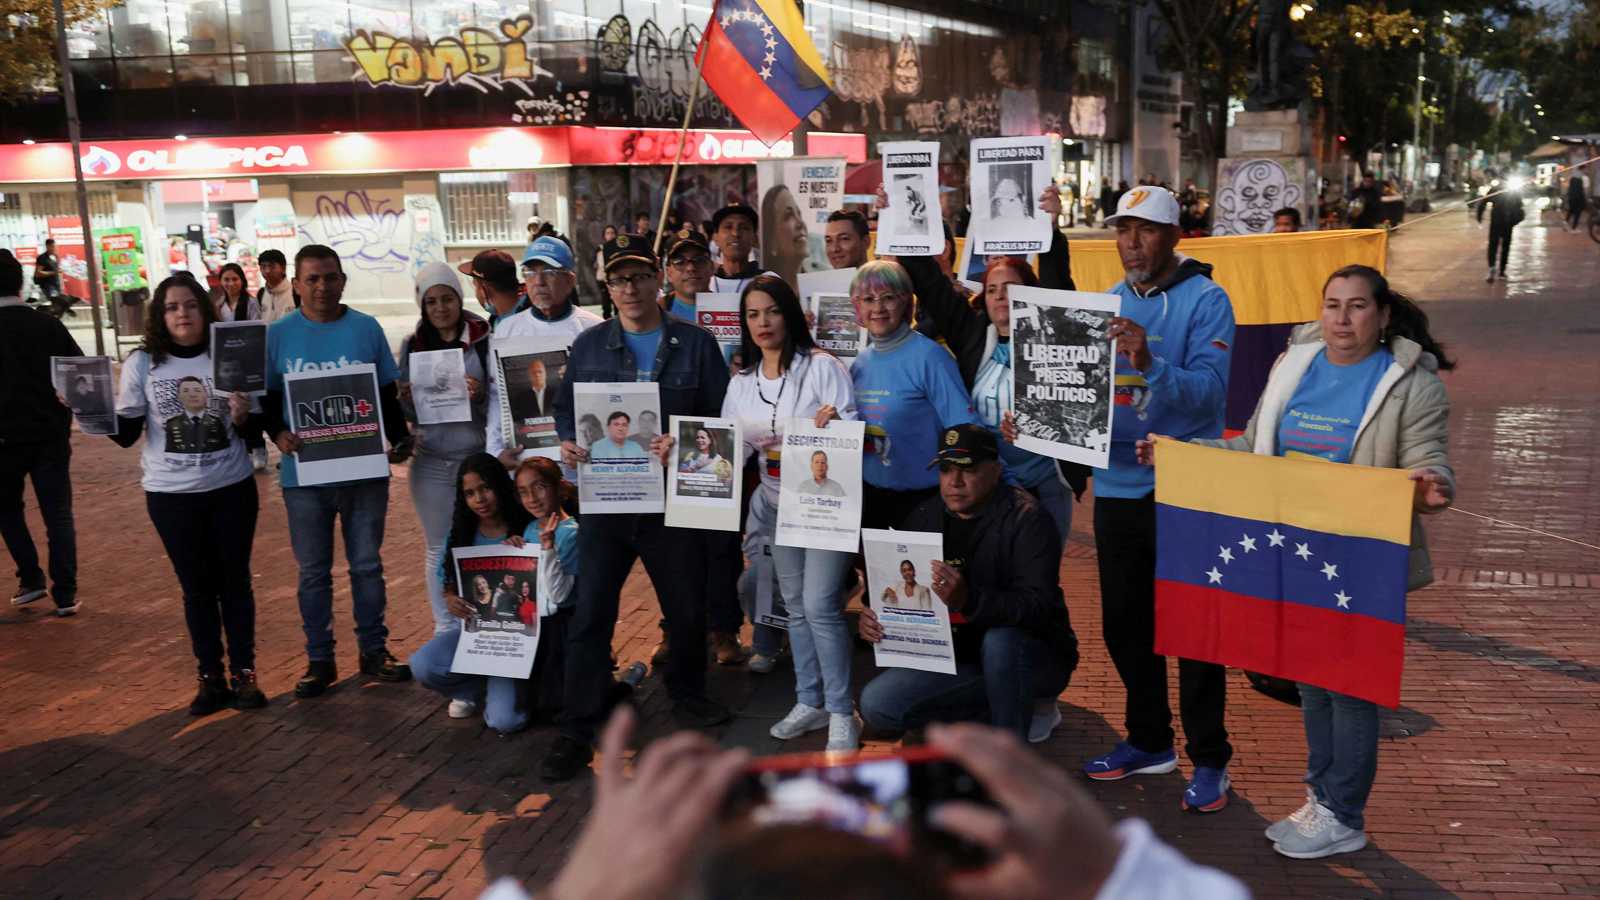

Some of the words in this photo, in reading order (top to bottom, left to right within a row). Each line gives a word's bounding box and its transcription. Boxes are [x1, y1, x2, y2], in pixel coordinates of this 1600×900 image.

[979, 149, 1017, 159] LIBERTAD
[1018, 147, 1042, 157] PARA
[799, 181, 809, 193] ES
[1023, 344, 1101, 364] LIBERTAD
[1035, 369, 1086, 385] PRESOS
[786, 434, 860, 450] SECUESTRADO
